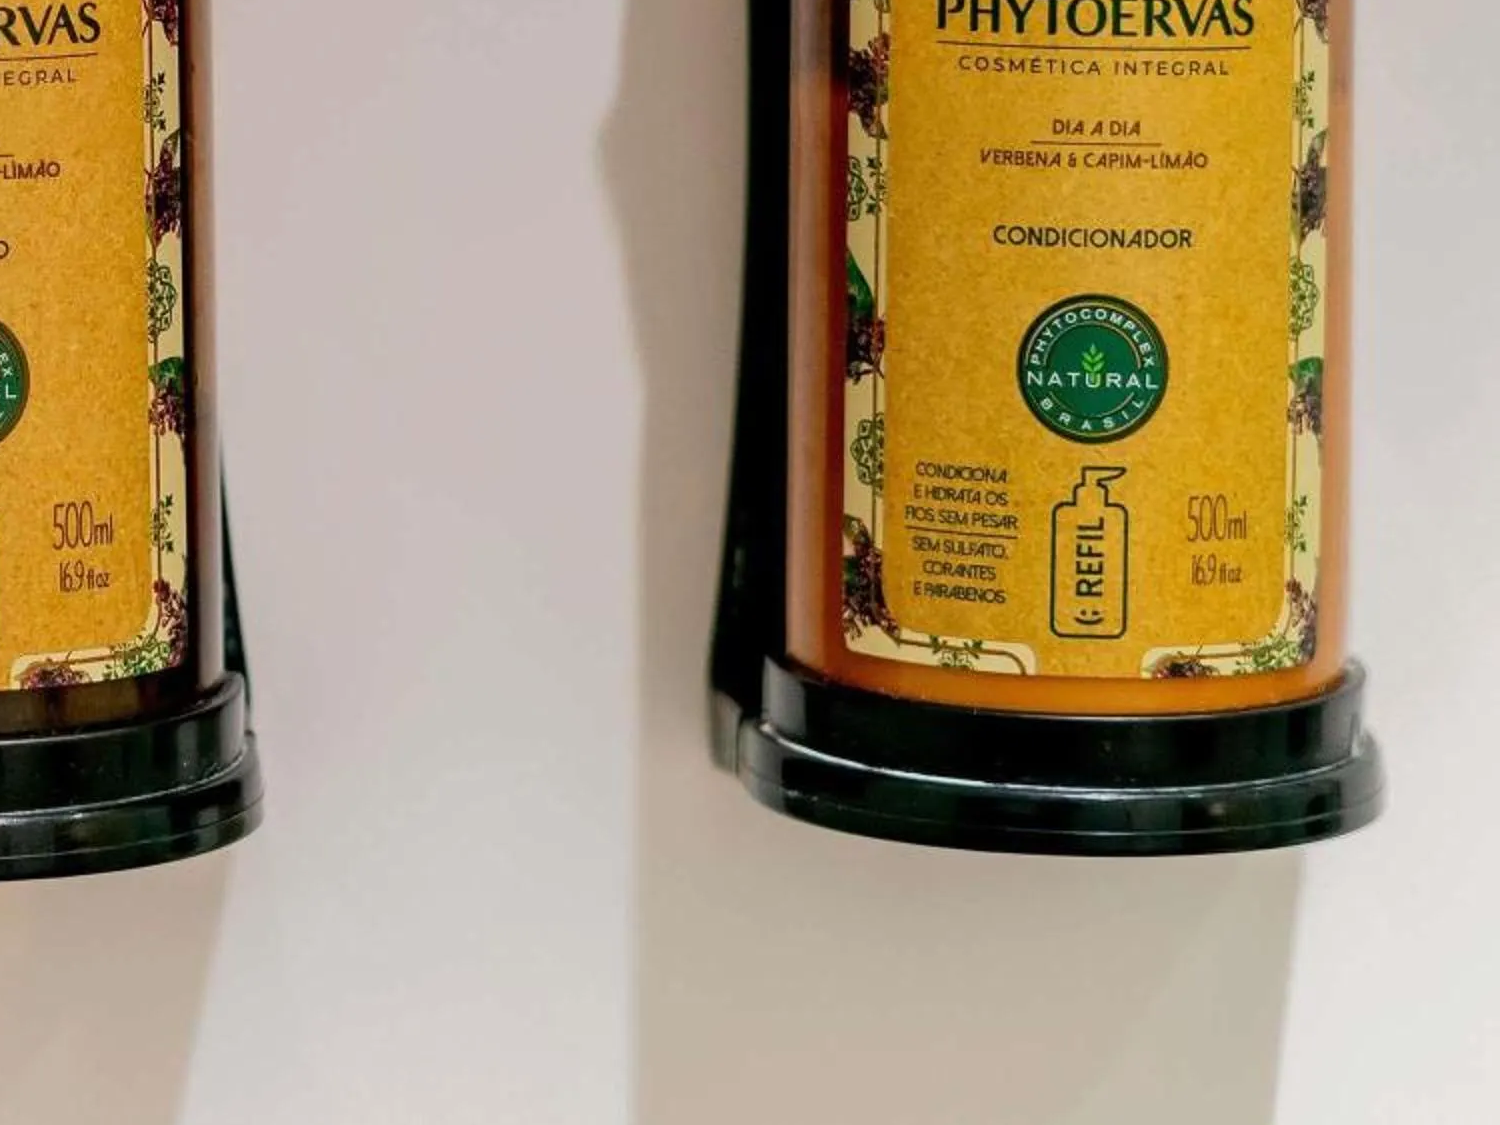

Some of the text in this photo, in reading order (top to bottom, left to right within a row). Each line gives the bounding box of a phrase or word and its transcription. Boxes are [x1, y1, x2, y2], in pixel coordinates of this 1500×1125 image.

[958, 54, 1229, 76] COSMÉTICA INTEGRAL
[1053, 119, 1141, 137] DIA A DIA
[980, 148, 1061, 168] VERBENA
[1068, 152, 1077, 168] &
[992, 223, 1193, 250] CONDICIONADOR
[1030, 308, 1156, 368] PHYTOCOMPLEX
[1027, 371, 1159, 389] NATURAL
[1040, 397, 1145, 431] BRASIL
[913, 483, 1008, 505] E HIDRATA OS
[53, 500, 113, 550] 500ml
[938, 508, 968, 525] SEM
[971, 512, 1018, 529] PESAR
[1187, 493, 1247, 542] 500ml
[912, 535, 940, 552] SEM
[1076, 516, 1104, 597] REFIL
